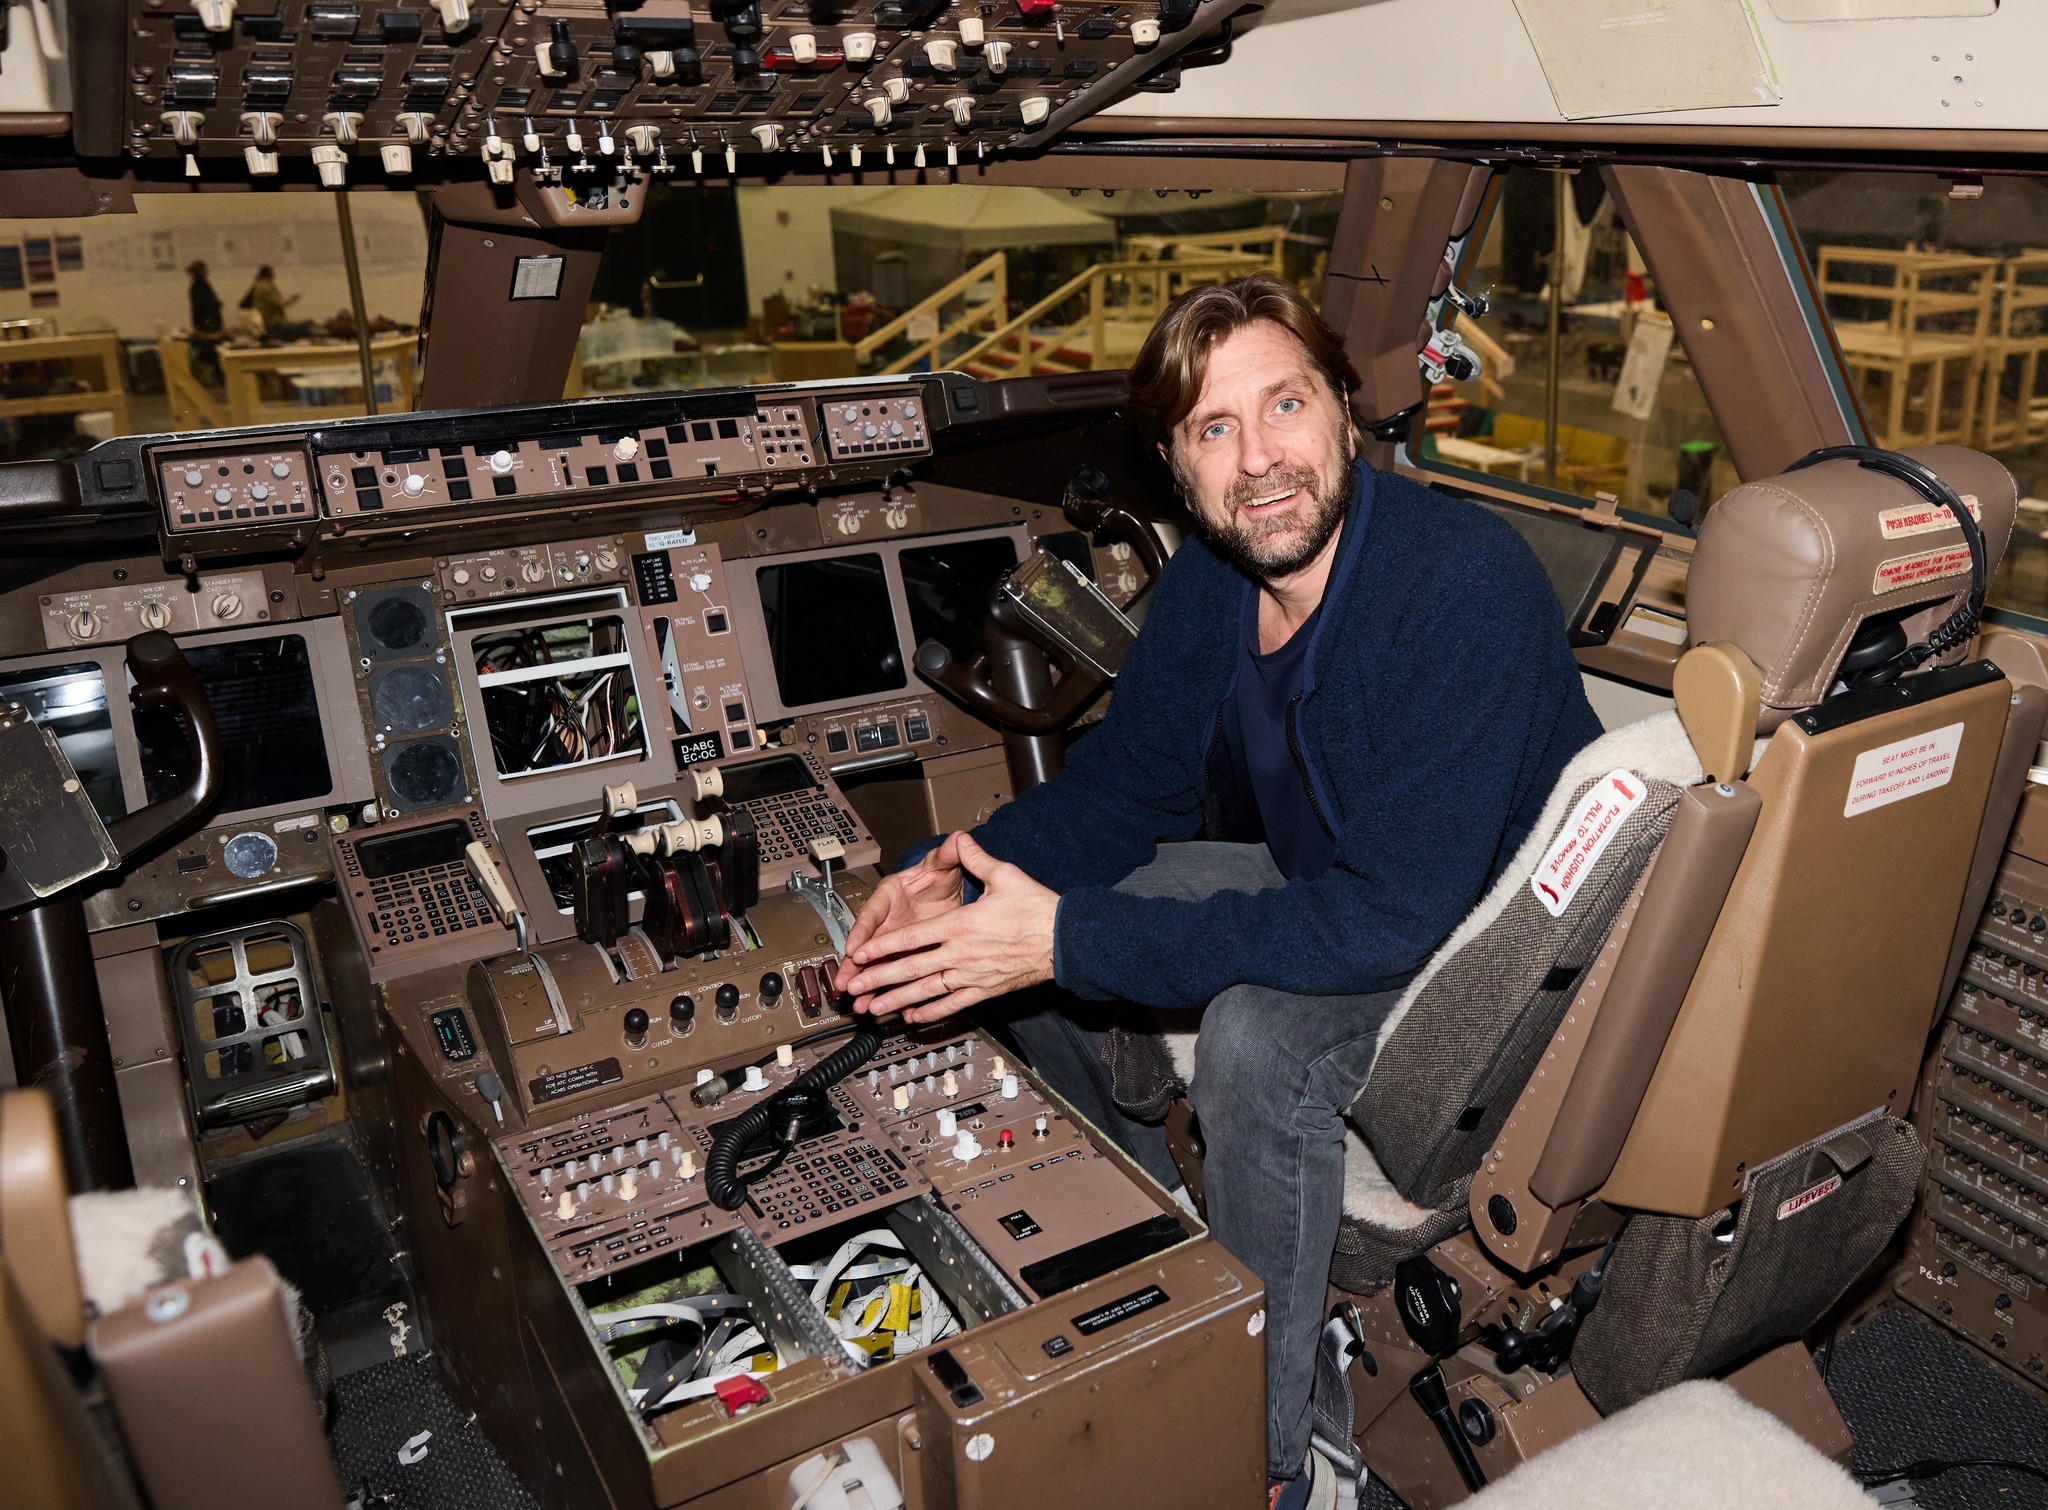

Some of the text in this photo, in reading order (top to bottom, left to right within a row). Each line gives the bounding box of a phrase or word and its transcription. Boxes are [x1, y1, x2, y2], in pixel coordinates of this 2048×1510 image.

[1886, 518, 1904, 530] PUSH
[1904, 512, 1933, 527] HEADREST
[1942, 509, 1952, 519] TO
[204, 579, 230, 587] STANDBY
[151, 585, 165, 593] CRT
[70, 601, 90, 609] NORM
[124, 600, 142, 608] EICAS
[49, 608, 68, 617] EICAS
[681, 740, 715, 754] D-ABC
[683, 749, 716, 763] EC-OC
[1882, 742, 1936, 765] SEAT MUST BE IN
[1856, 772, 1887, 788] FORWARD
[1895, 763, 1917, 775] INCHES
[1919, 760, 1928, 768] OF
[1929, 752, 1951, 765] TRAVEL
[705, 776, 713, 786] 4
[1852, 767, 1949, 805] DURING TAKEOFF AND LANDING
[620, 793, 625, 804] 1
[704, 829, 713, 839] 3
[1550, 800, 1603, 874] PULL TO REMOVE
[677, 837, 685, 847] 2
[817, 839, 835, 847] FLAP
[1560, 804, 1620, 891] FLOTATION CUSHION
[797, 959, 810, 967] STAB
[650, 1016, 662, 1024] RUN
[742, 1014, 762, 1024] CUTOFF
[819, 1015, 841, 1026] CUTOUT
[652, 1039, 673, 1048] CUTOFF
[1788, 1179, 1837, 1212] LIFEVEST
[1021, 1224, 1037, 1232] EMPTY
[1016, 1231, 1032, 1239] PAPER
[1919, 1265, 1944, 1286] P6-5
[1410, 1286, 1426, 1324] UP-DOWN
[1415, 1288, 1430, 1319] LUMBAR
